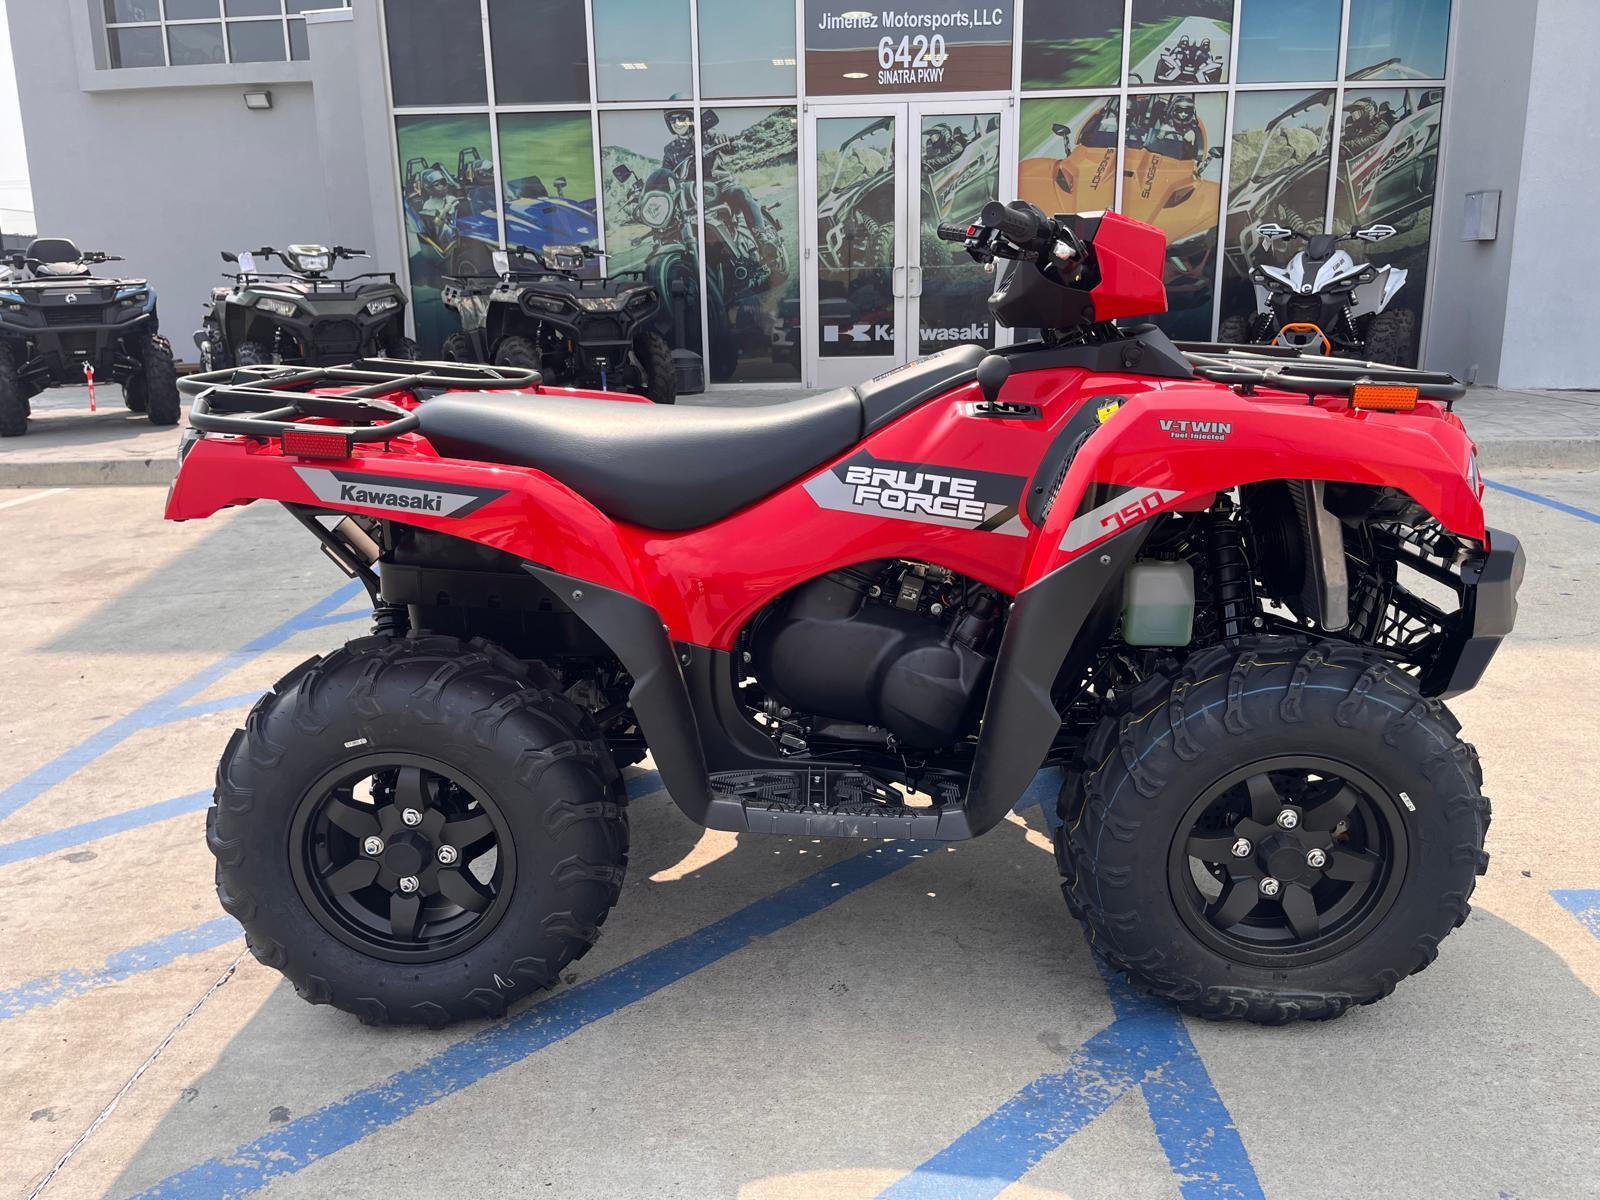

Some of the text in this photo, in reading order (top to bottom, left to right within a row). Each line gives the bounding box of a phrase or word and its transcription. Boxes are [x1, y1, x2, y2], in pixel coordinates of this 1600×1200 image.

[818, 12, 879, 30] Jimenez
[878, 33, 945, 70] 6420
[878, 67, 944, 85] SINATRA PKWY
[1159, 419, 1231, 434] V-TWIN
[845, 465, 977, 499] BRUTE
[340, 484, 442, 511] Kawasaki
[853, 485, 986, 521] FORCE
[1100, 491, 1165, 528] 750
